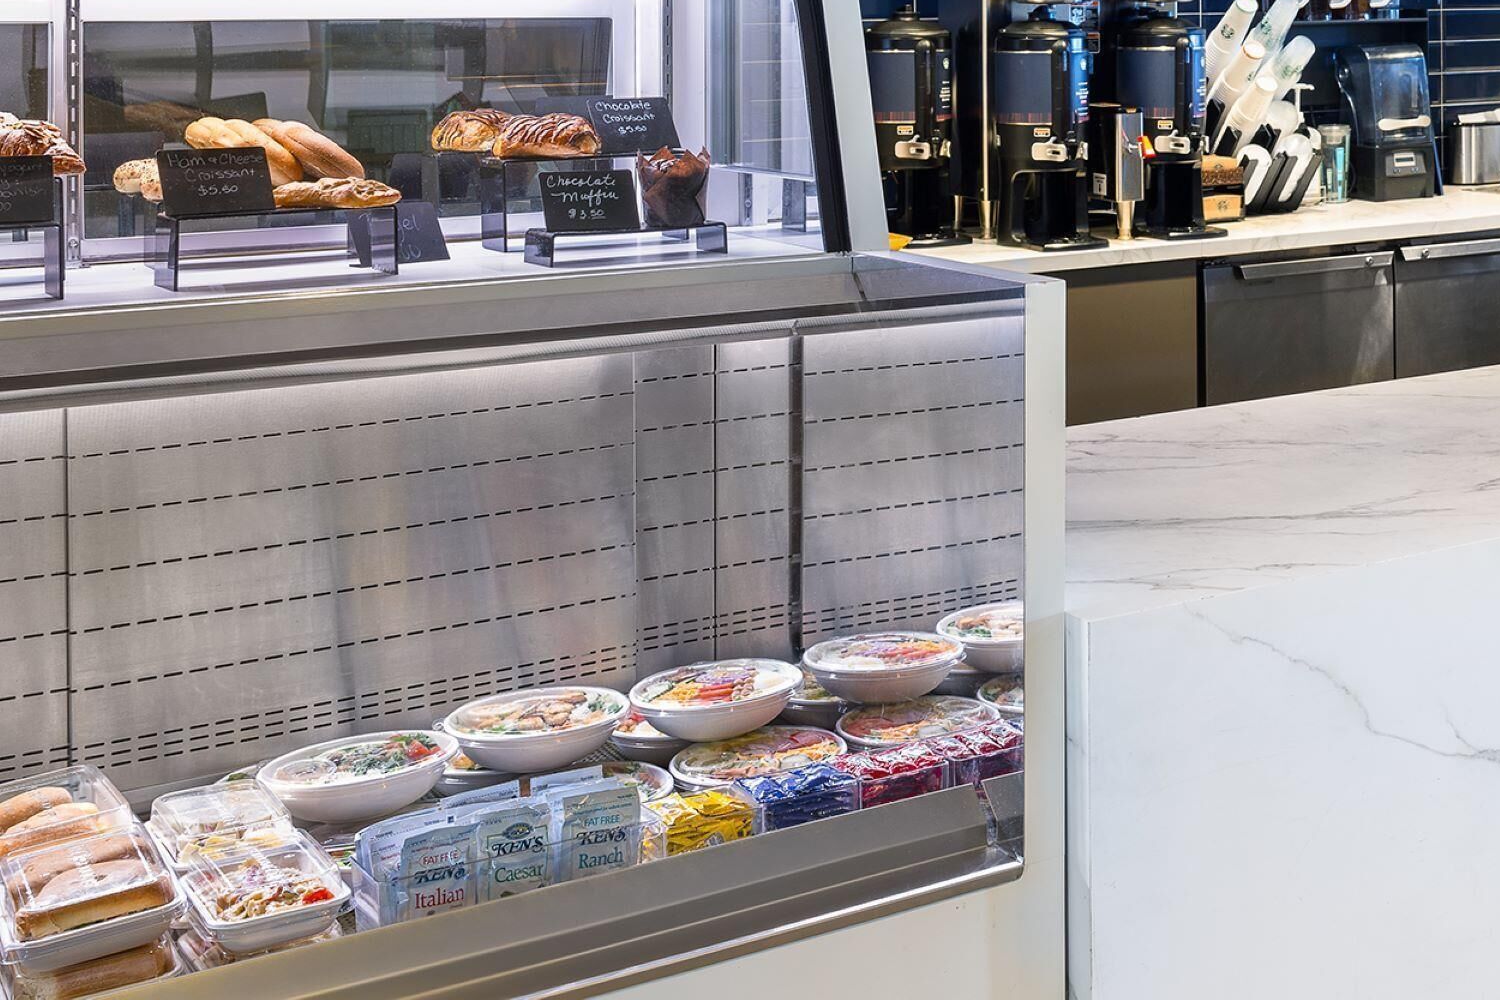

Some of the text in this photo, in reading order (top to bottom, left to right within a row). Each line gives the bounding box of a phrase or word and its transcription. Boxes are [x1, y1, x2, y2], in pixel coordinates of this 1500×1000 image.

[595, 100, 652, 112] Chocolate
[602, 112, 656, 124] Croissant
[168, 153, 205, 168] Ham
[220, 153, 264, 165] Cheese
[184, 168, 256, 182] Croissant
[546, 173, 616, 188] Chocolate
[584, 814, 620, 827] FAT FREE
[422, 855, 439, 865] FAT
[579, 847, 624, 870] Ranch
[494, 864, 544, 884] Caesar
[415, 887, 465, 910] Italian
